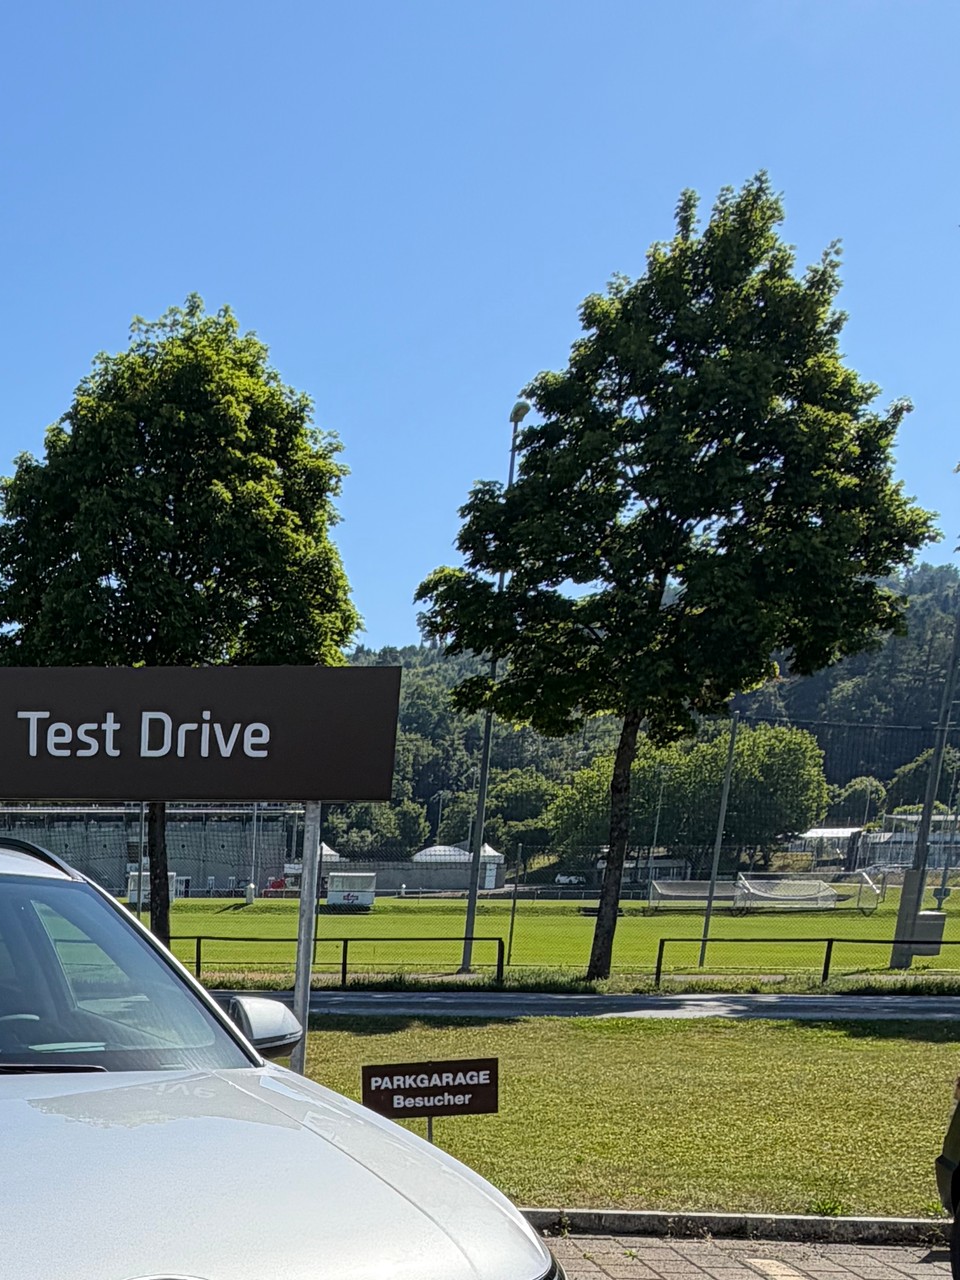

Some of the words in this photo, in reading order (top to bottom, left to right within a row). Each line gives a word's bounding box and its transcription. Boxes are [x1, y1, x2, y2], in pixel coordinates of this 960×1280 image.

[17, 710, 121, 758] Test
[141, 710, 272, 758] Drive
[370, 1070, 491, 1091] PARKGARAGE
[393, 1092, 472, 1108] Besucher
